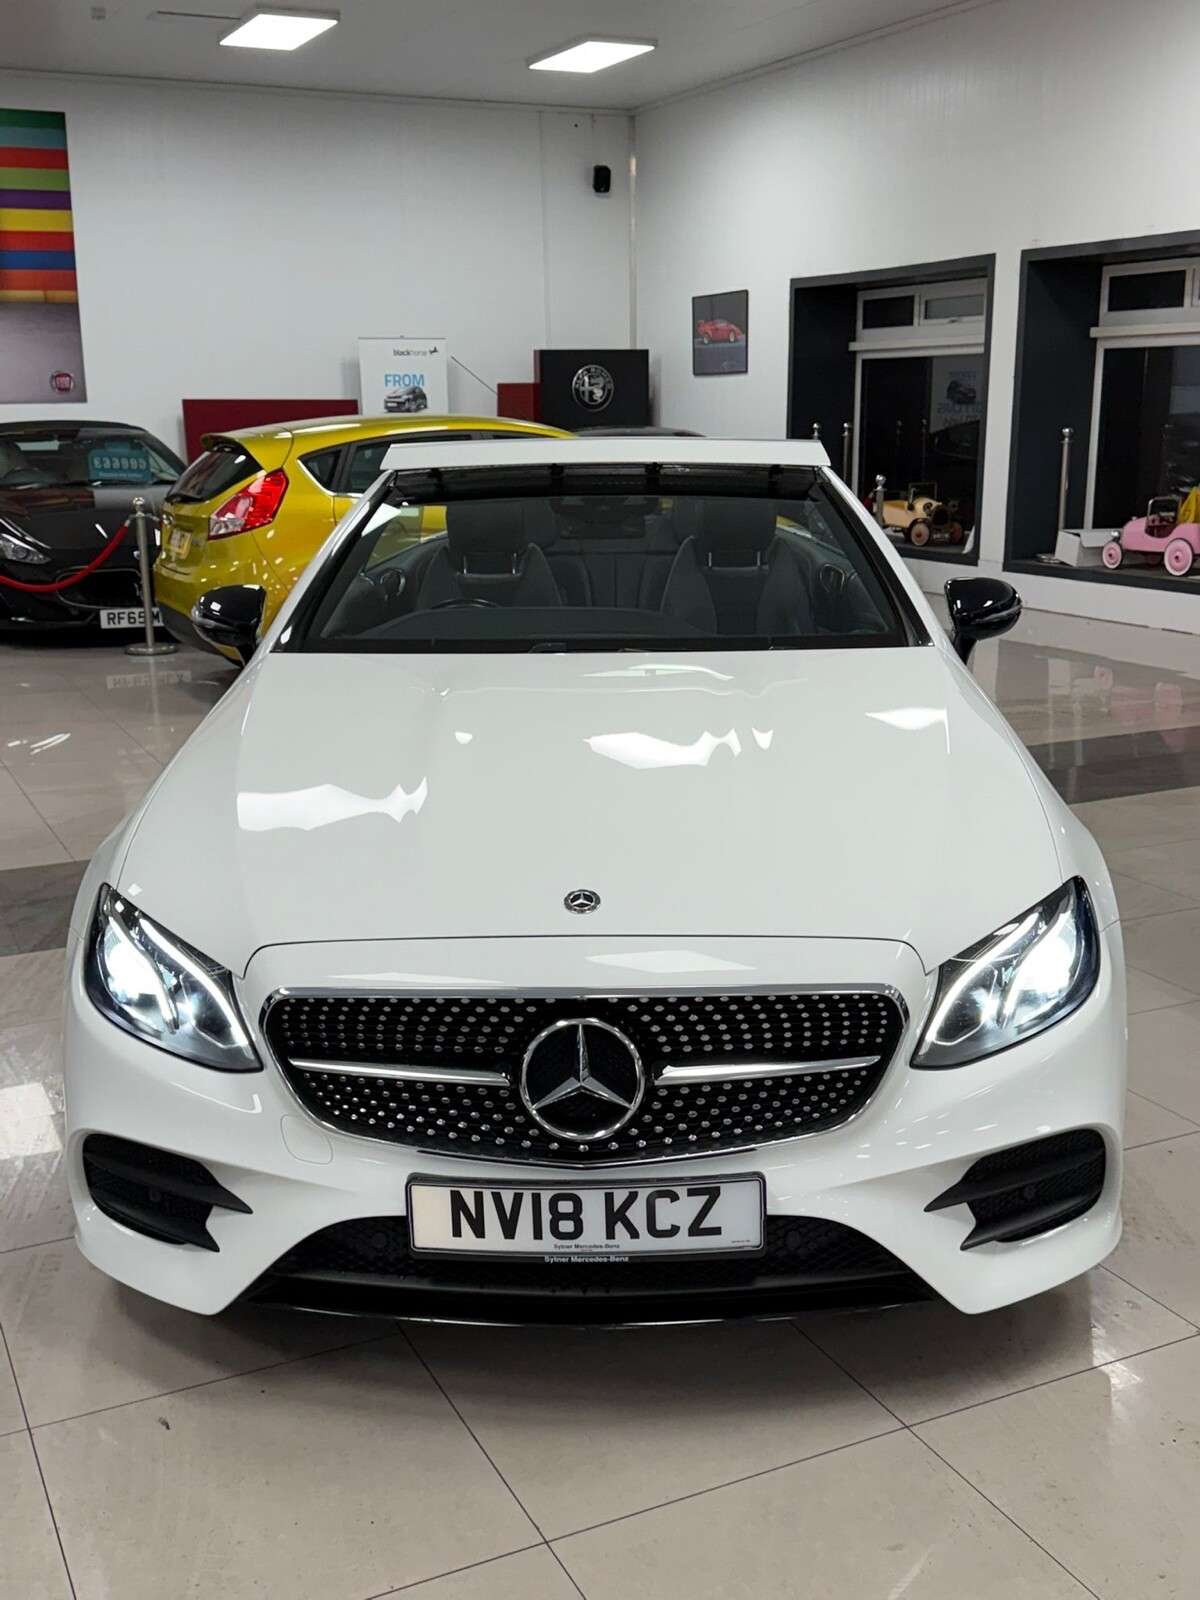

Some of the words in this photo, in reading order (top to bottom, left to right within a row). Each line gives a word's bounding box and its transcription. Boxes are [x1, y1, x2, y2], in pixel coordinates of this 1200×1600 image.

[384, 374, 425, 387] FROM
[449, 1190, 584, 1241] NV18
[604, 1186, 723, 1240] KCZ
[570, 1255, 629, 1263] Mercedes-Benz
